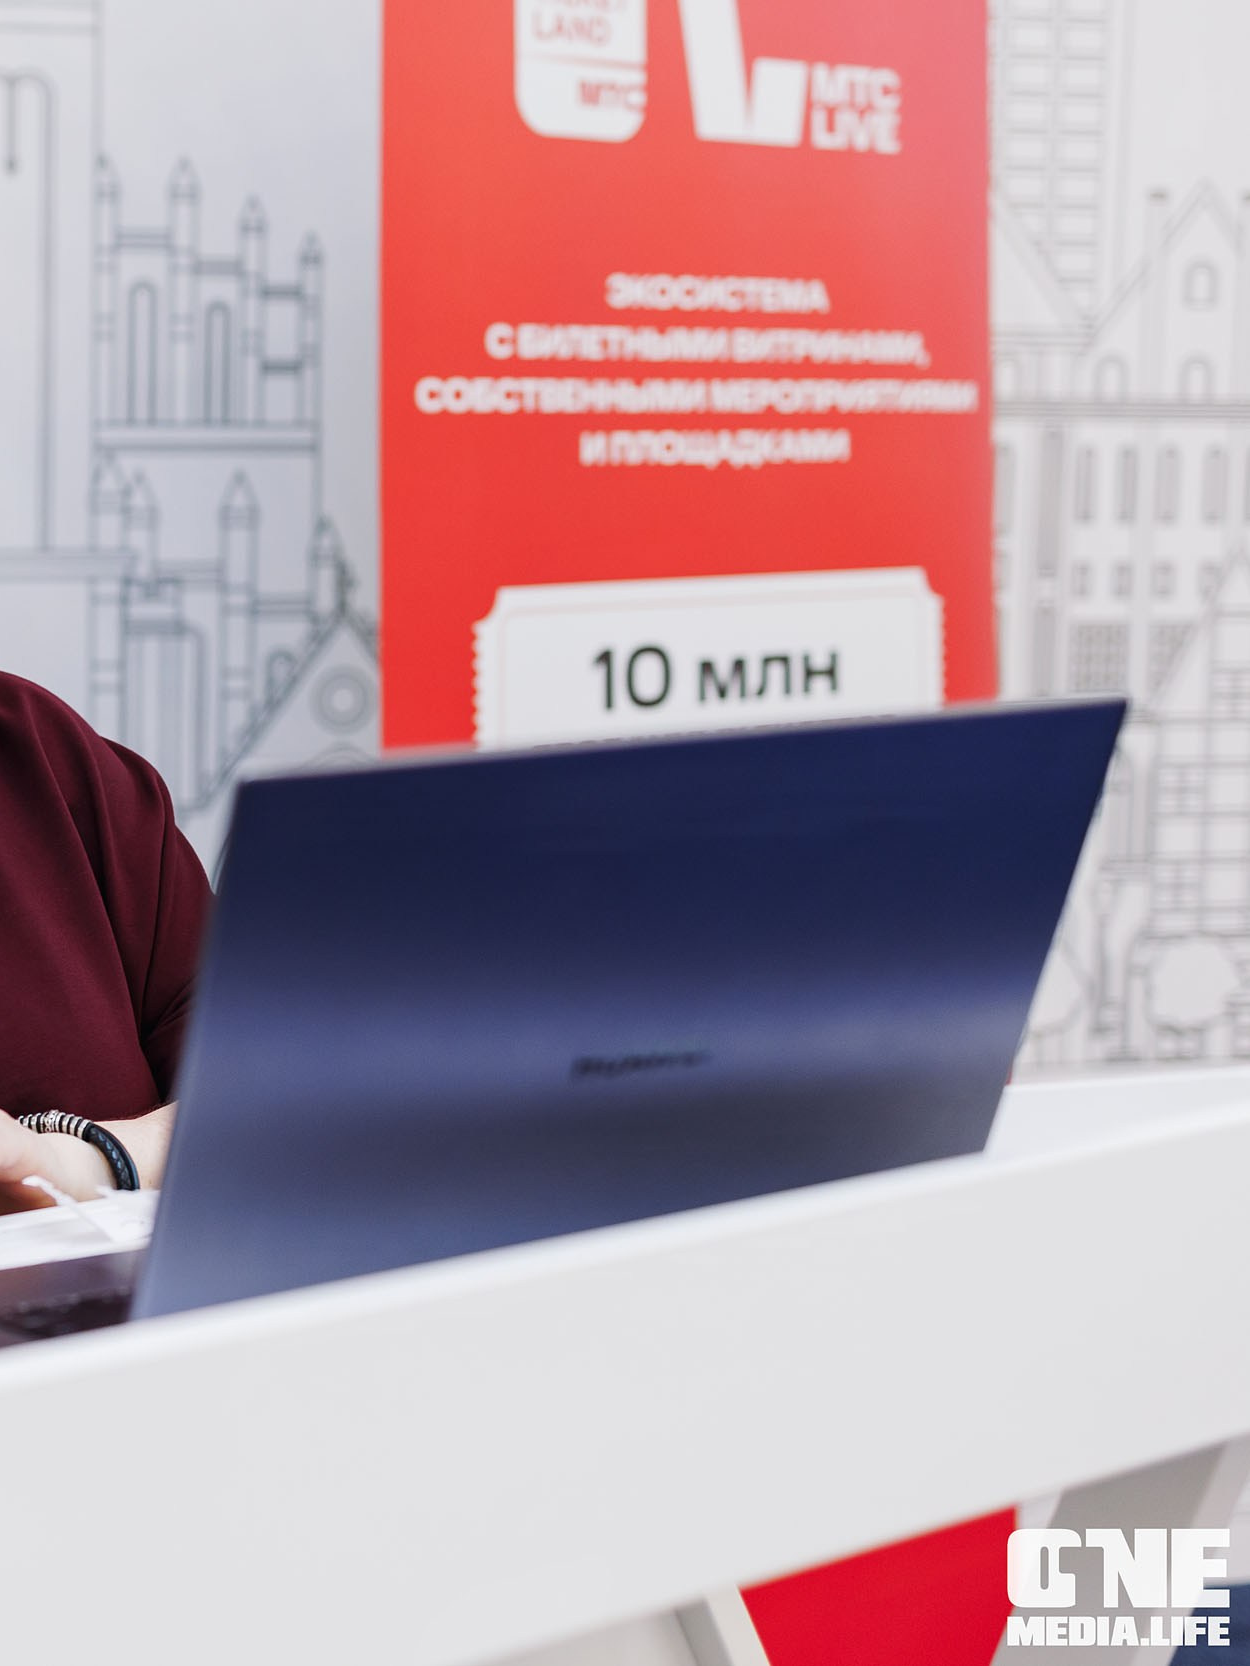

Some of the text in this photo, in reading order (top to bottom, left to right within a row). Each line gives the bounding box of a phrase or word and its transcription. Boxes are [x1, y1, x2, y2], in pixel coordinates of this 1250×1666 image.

[811, 107, 901, 154] LIVE
[606, 272, 830, 313] ЭКОСИСТЕМА
[485, 322, 930, 367] С БИЛЕТНЫМИ ВИТРИНАМИ,
[415, 376, 979, 413] СОБСТВЕННЫМИ МЕРОПРИЯТИЯМИ
[580, 428, 850, 469] И ПЛОЩАДКАМИ
[593, 645, 839, 709] 10 млн
